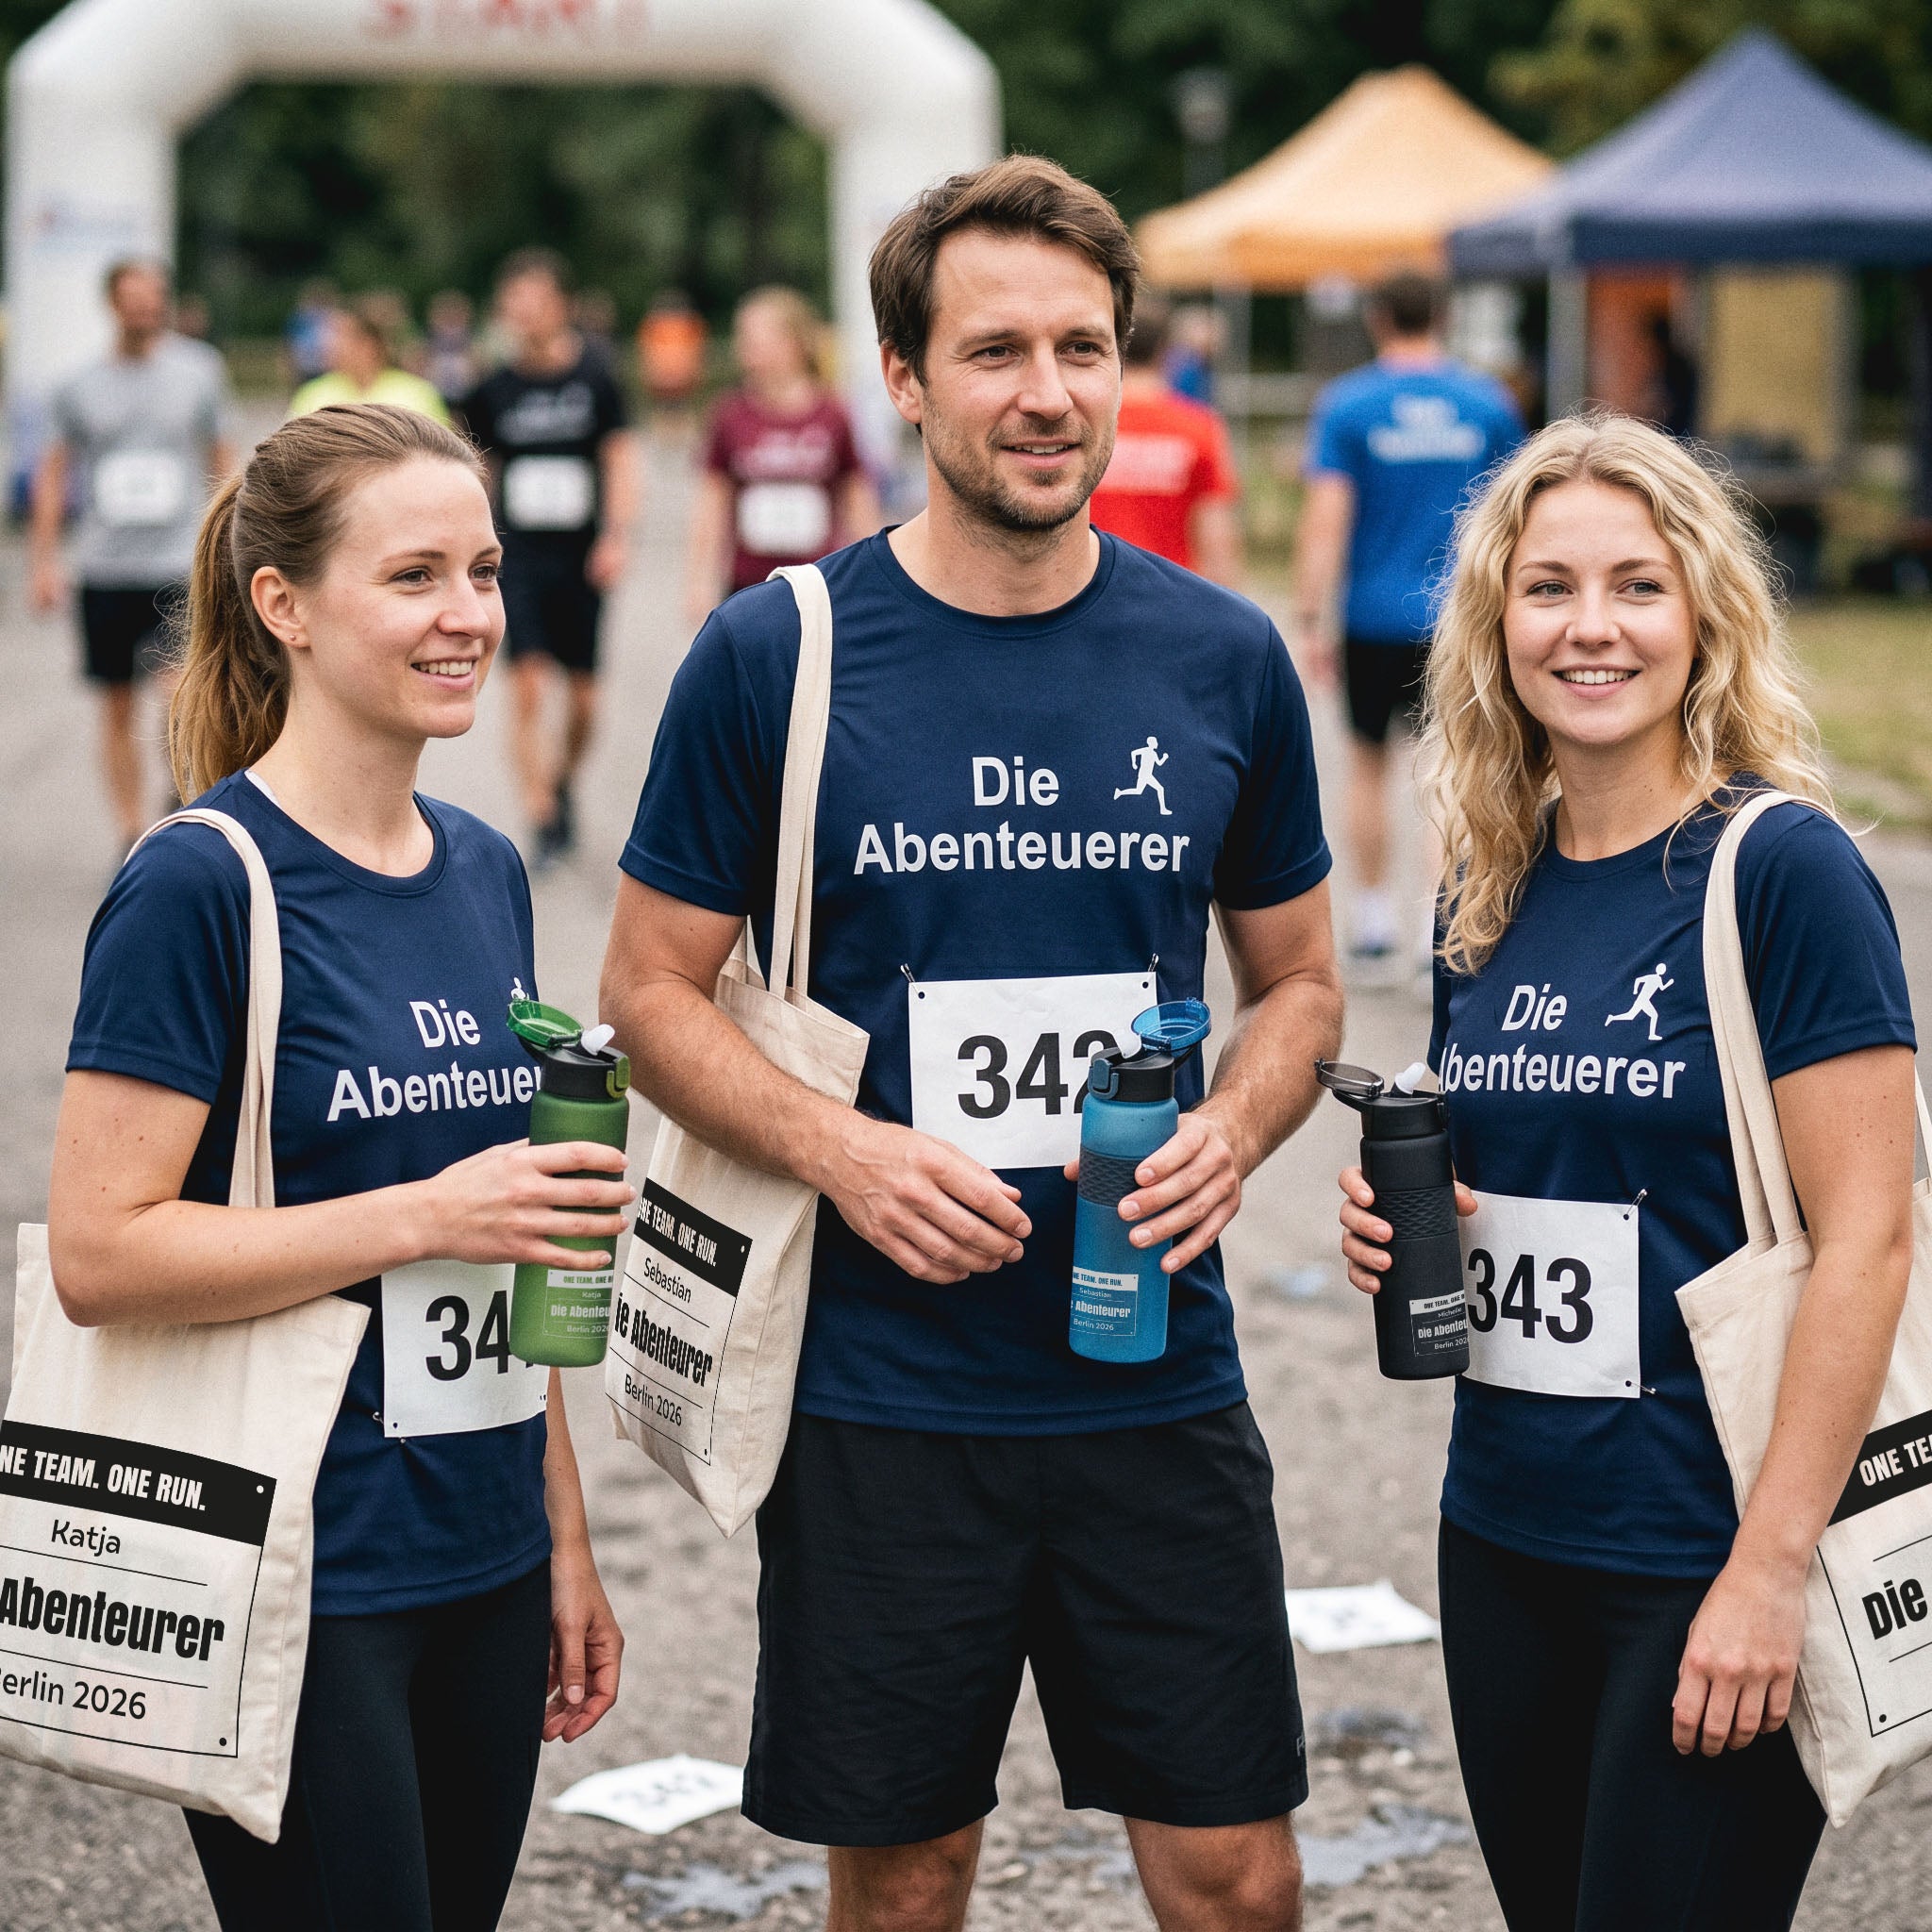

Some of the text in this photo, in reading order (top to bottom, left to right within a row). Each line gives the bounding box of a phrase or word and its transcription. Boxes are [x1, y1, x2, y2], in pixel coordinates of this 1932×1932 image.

[972, 756, 1059, 807] Die
[854, 821, 1191, 875] Abenteuerer
[408, 999, 481, 1049] Die
[1501, 983, 1568, 1032] Die
[652, 1205, 675, 1242] TEAM.
[677, 1223, 697, 1255] ONE
[695, 1236, 717, 1267] RUN.
[643, 1257, 691, 1304] Sebastian
[1079, 1287, 1111, 1298] Sebastian
[1467, 1248, 1594, 1344] 343
[550, 1304, 567, 1317] Die
[566, 1324, 590, 1333] Berlin
[1074, 1300, 1131, 1318] Abenteurer
[1074, 1318, 1114, 1331] Berlin 2026
[1418, 1326, 1432, 1339] Die
[1438, 1307, 1462, 1318] Michelle
[425, 1290, 535, 1381] 34
[630, 1308, 713, 1387] Abenteurer
[1434, 1338, 1468, 1349] Berlin 202
[625, 1374, 683, 1427] Berlin 2026
[34, 1450, 100, 1489] TEAM.
[107, 1464, 153, 1499] ONE
[156, 1474, 207, 1511] RUN.
[1858, 1434, 1932, 1487] ONE TE
[51, 1519, 122, 1557] Katja
[0, 1576, 225, 1662] Abenteurer
[1861, 1578, 1928, 1641] Die
[0, 1668, 146, 1721] erlin 2026
